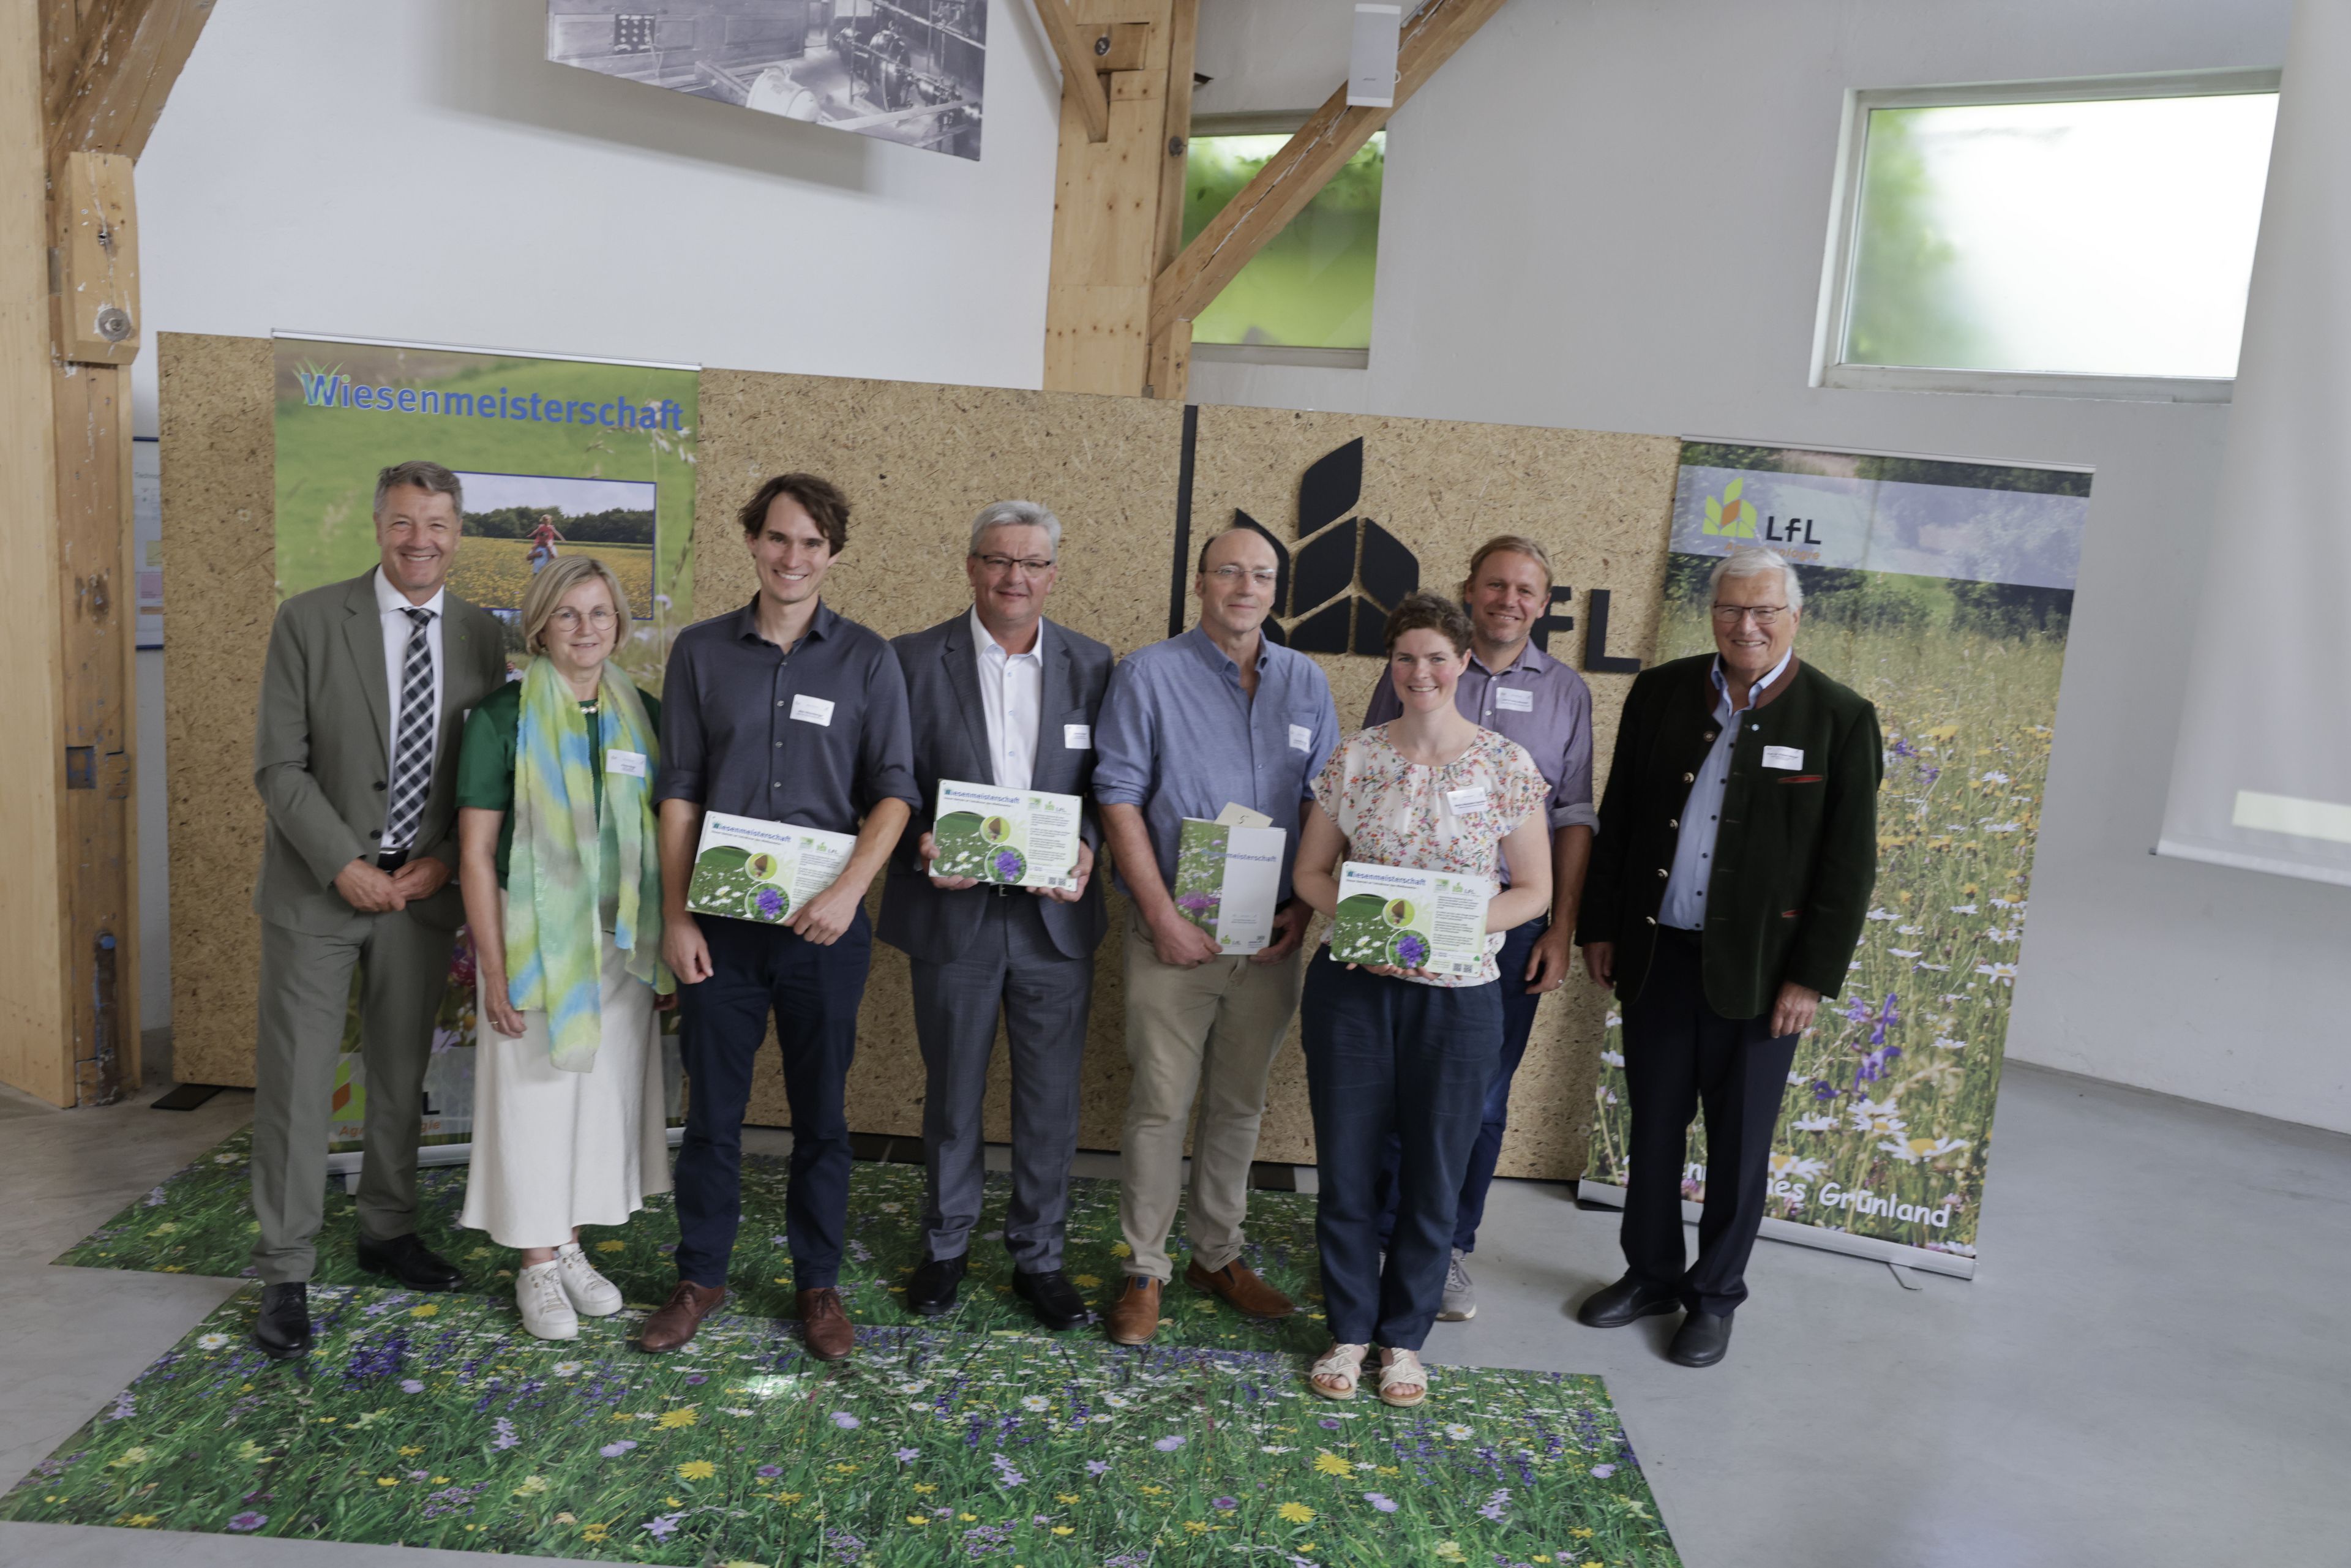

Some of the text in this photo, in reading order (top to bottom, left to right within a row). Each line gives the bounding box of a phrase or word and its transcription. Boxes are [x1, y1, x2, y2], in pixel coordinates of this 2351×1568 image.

[301, 373, 684, 431] Wiesenmeisterschaft
[1766, 516, 1821, 545] LfL
[1819, 1182, 1952, 1228] Grünland
